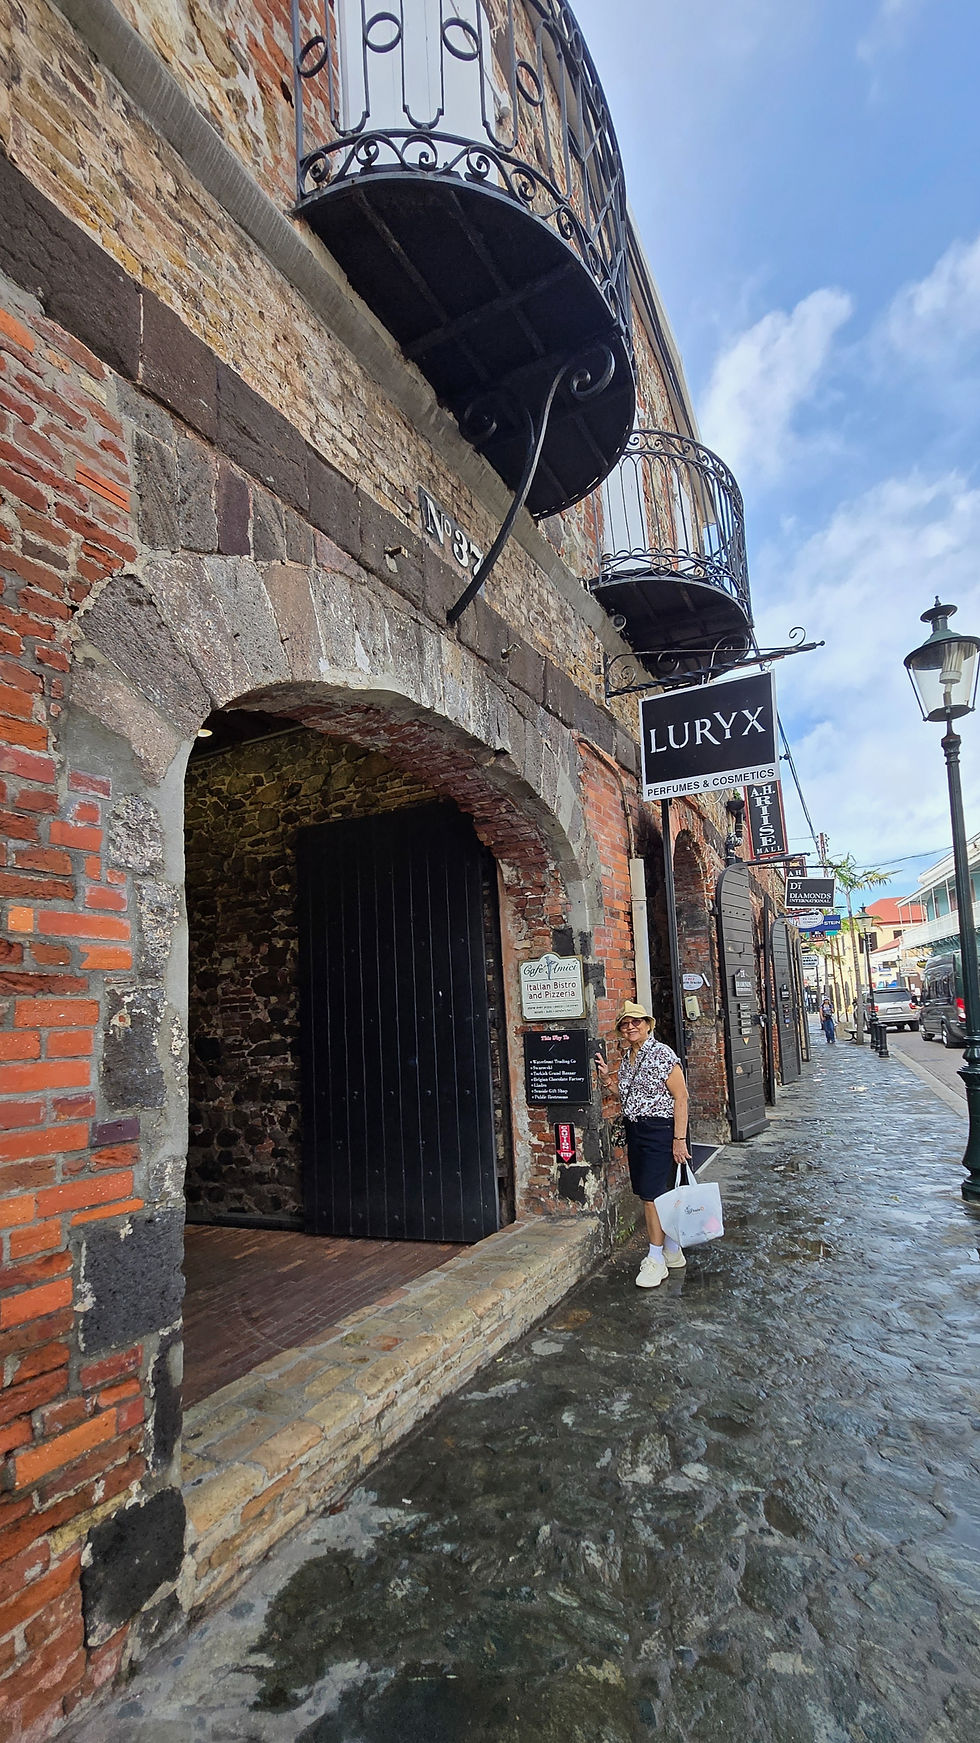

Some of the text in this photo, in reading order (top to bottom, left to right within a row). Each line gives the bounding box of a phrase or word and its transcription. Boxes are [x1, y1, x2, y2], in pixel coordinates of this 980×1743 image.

[650, 706, 766, 753] LURYX
[647, 768, 775, 796] PERFUMES & COSMETICS
[756, 846, 782, 854] MALL
[526, 983, 551, 991] Italian
